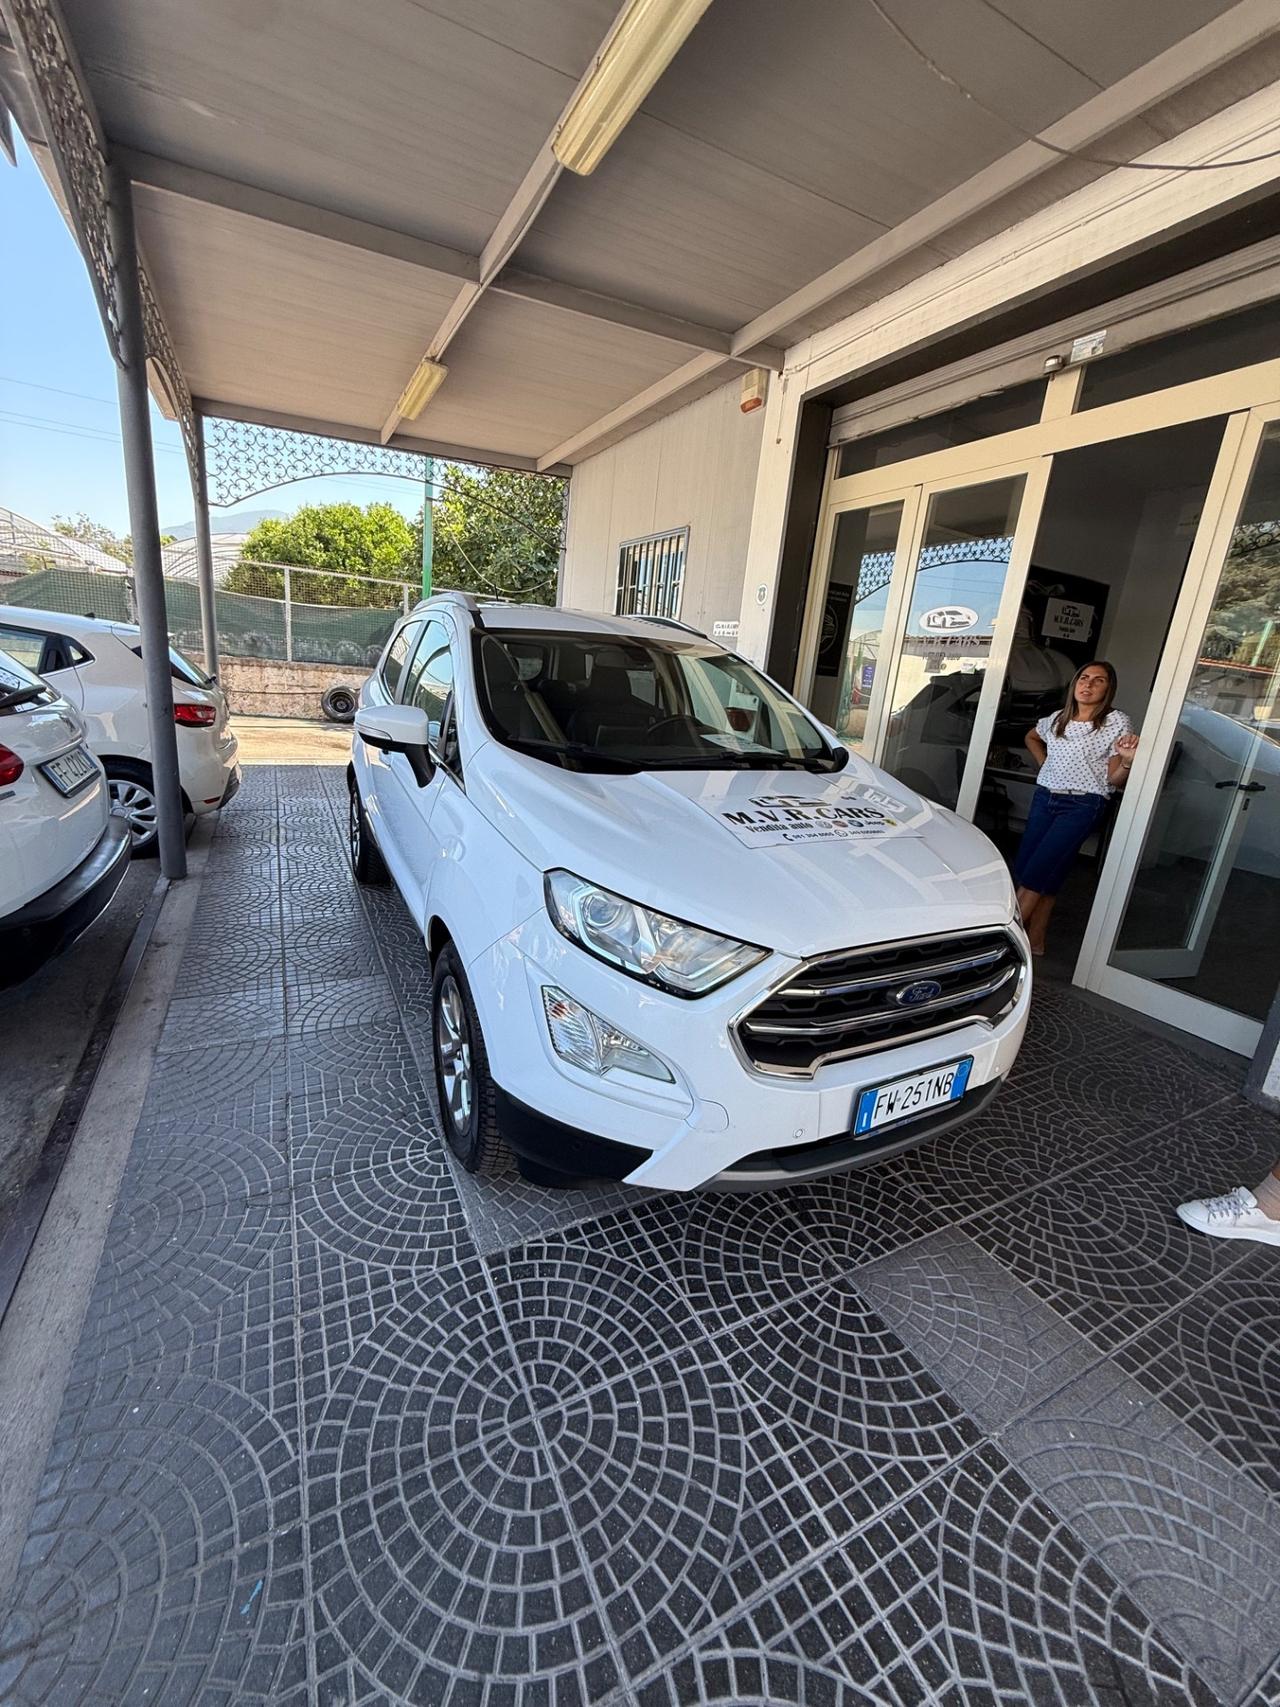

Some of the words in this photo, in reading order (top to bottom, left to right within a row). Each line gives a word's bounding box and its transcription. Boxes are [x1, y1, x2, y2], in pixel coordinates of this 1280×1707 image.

[745, 822, 789, 834] Vendita
[790, 821, 814, 831] auto
[909, 986, 935, 1002] Ford
